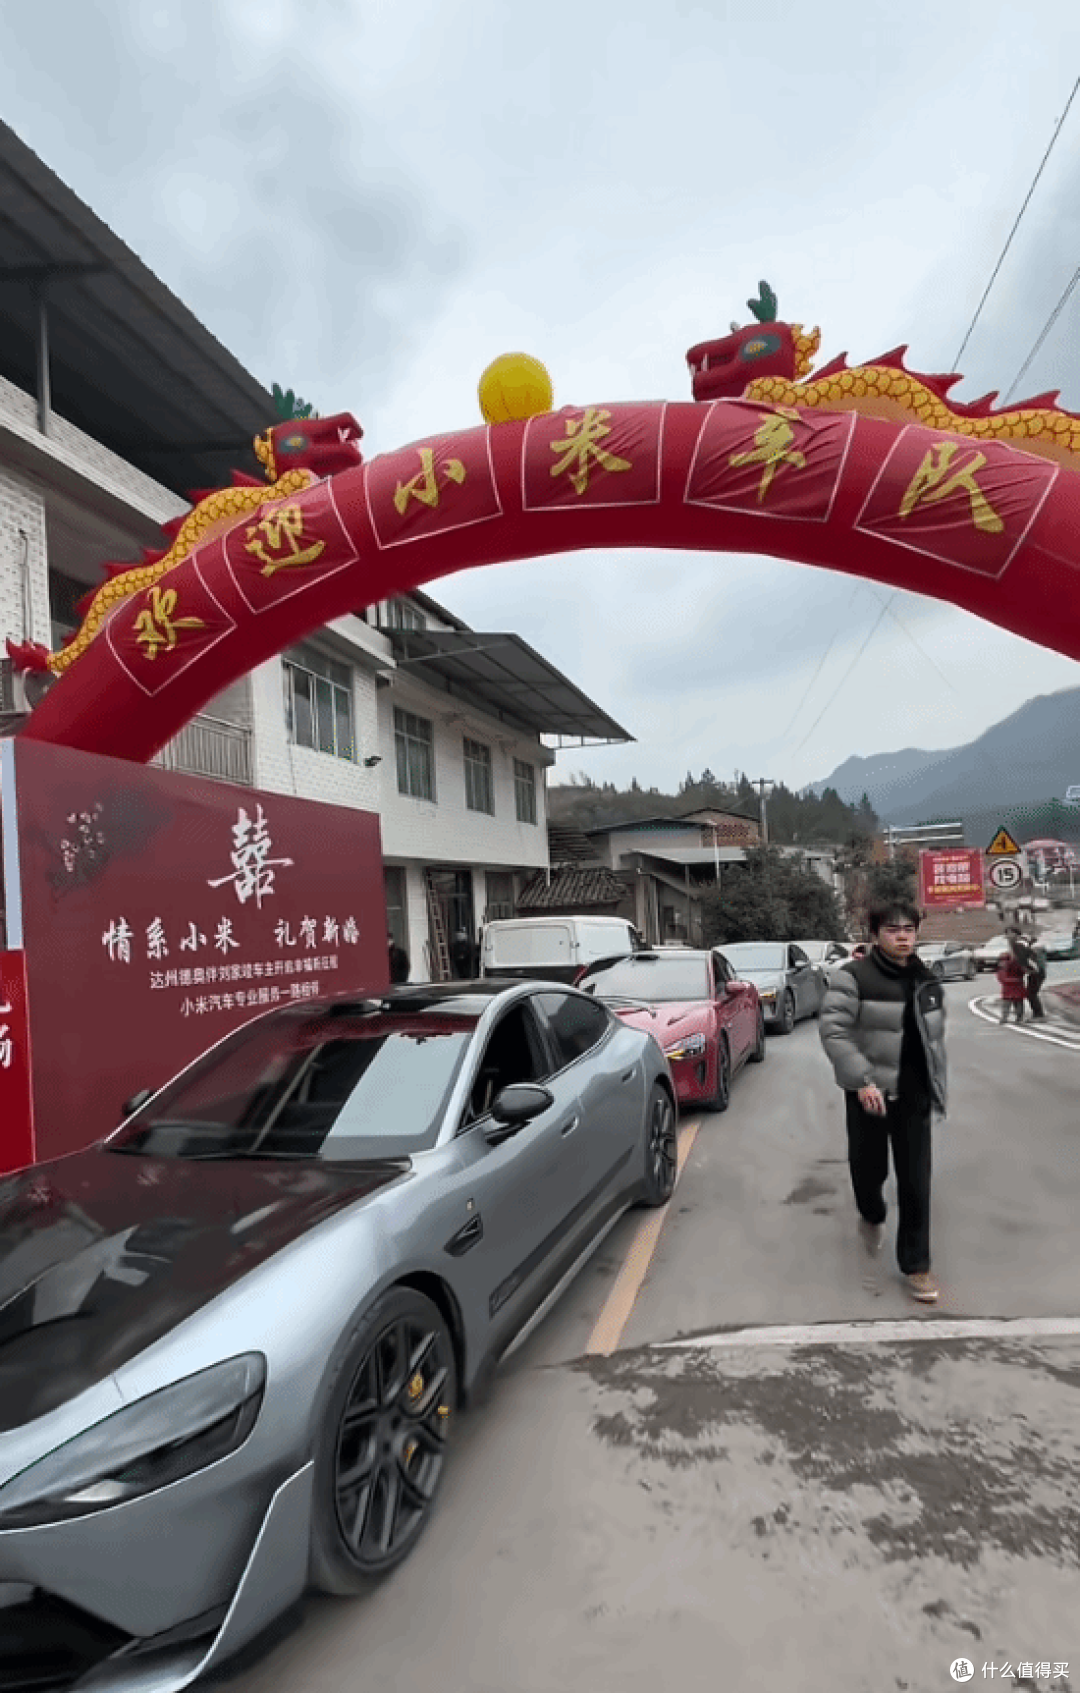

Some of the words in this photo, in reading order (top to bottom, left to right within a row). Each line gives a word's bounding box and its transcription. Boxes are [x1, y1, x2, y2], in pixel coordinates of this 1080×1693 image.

[131, 404, 1004, 661] 欢迎小米车队
[998, 867, 1014, 882] 15
[101, 915, 240, 964] 情系小米
[273, 915, 360, 949] 礼贺新婚
